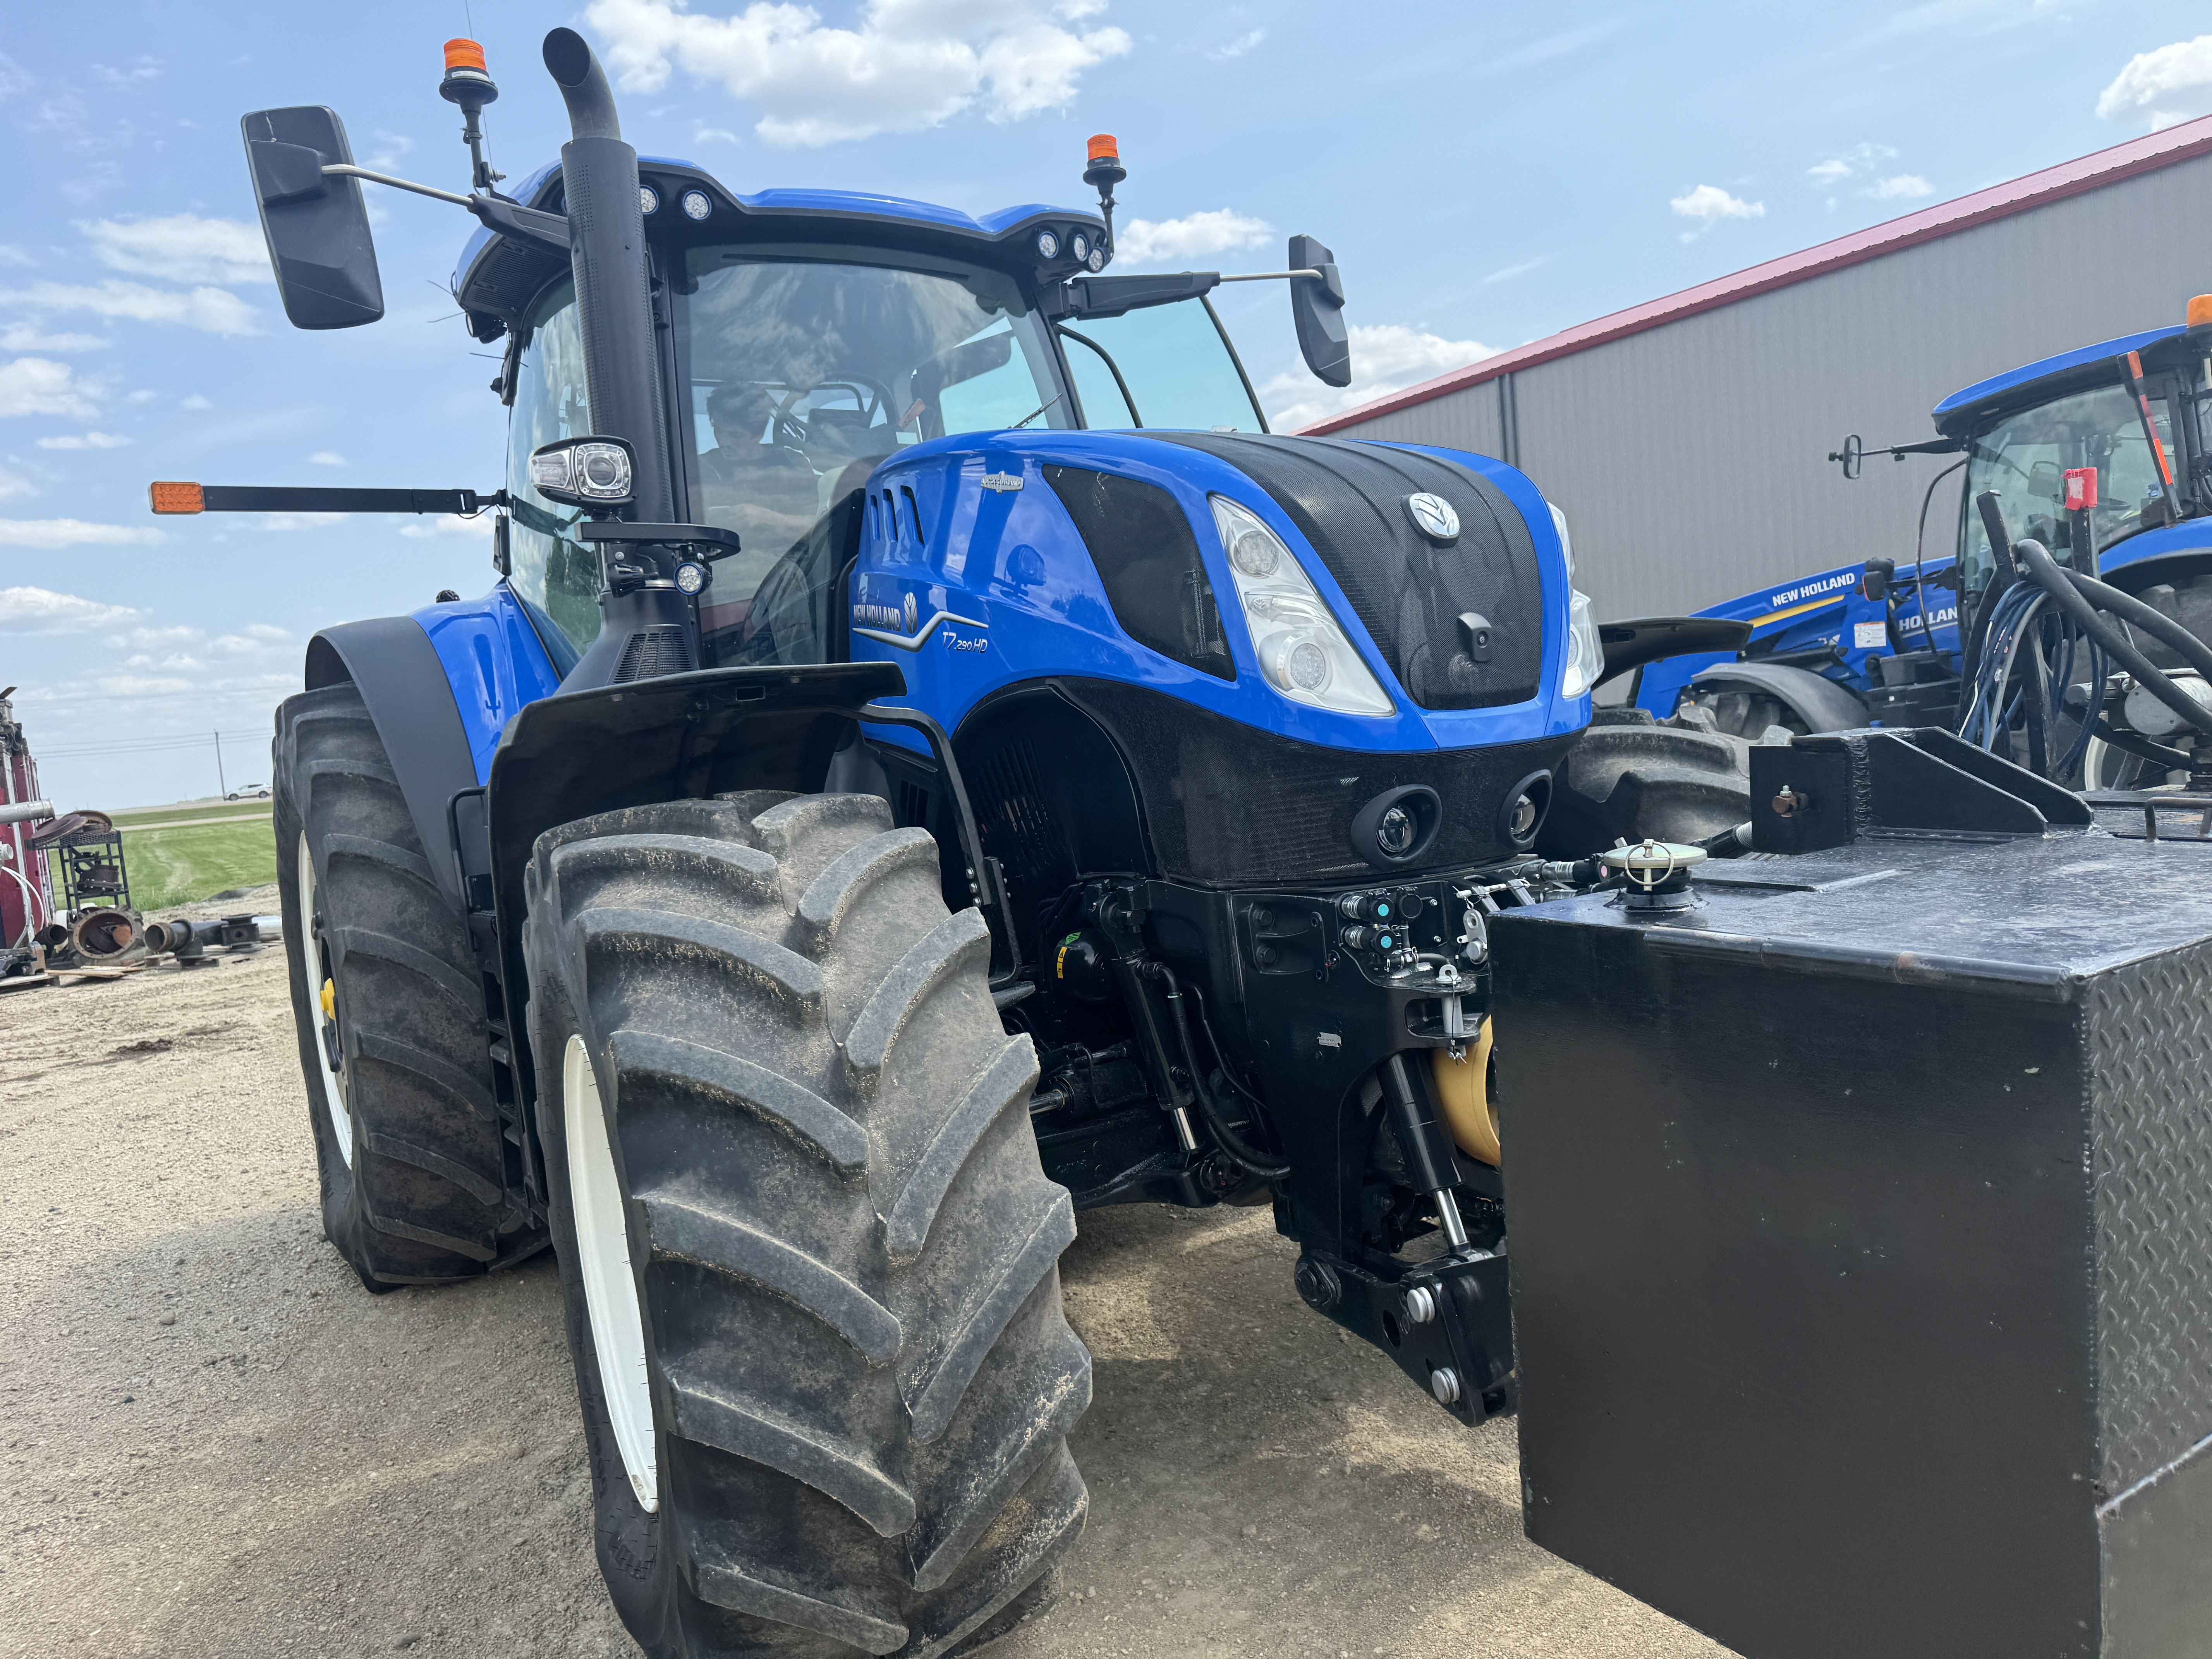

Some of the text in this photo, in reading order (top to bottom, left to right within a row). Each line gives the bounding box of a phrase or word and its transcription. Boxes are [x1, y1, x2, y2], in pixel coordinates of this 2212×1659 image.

[1772, 573, 1855, 607] NEW HOLLAND
[854, 604, 901, 632] NEW HOLLAND
[1899, 606, 1958, 631] HOLAN
[973, 638, 988, 653] HD
